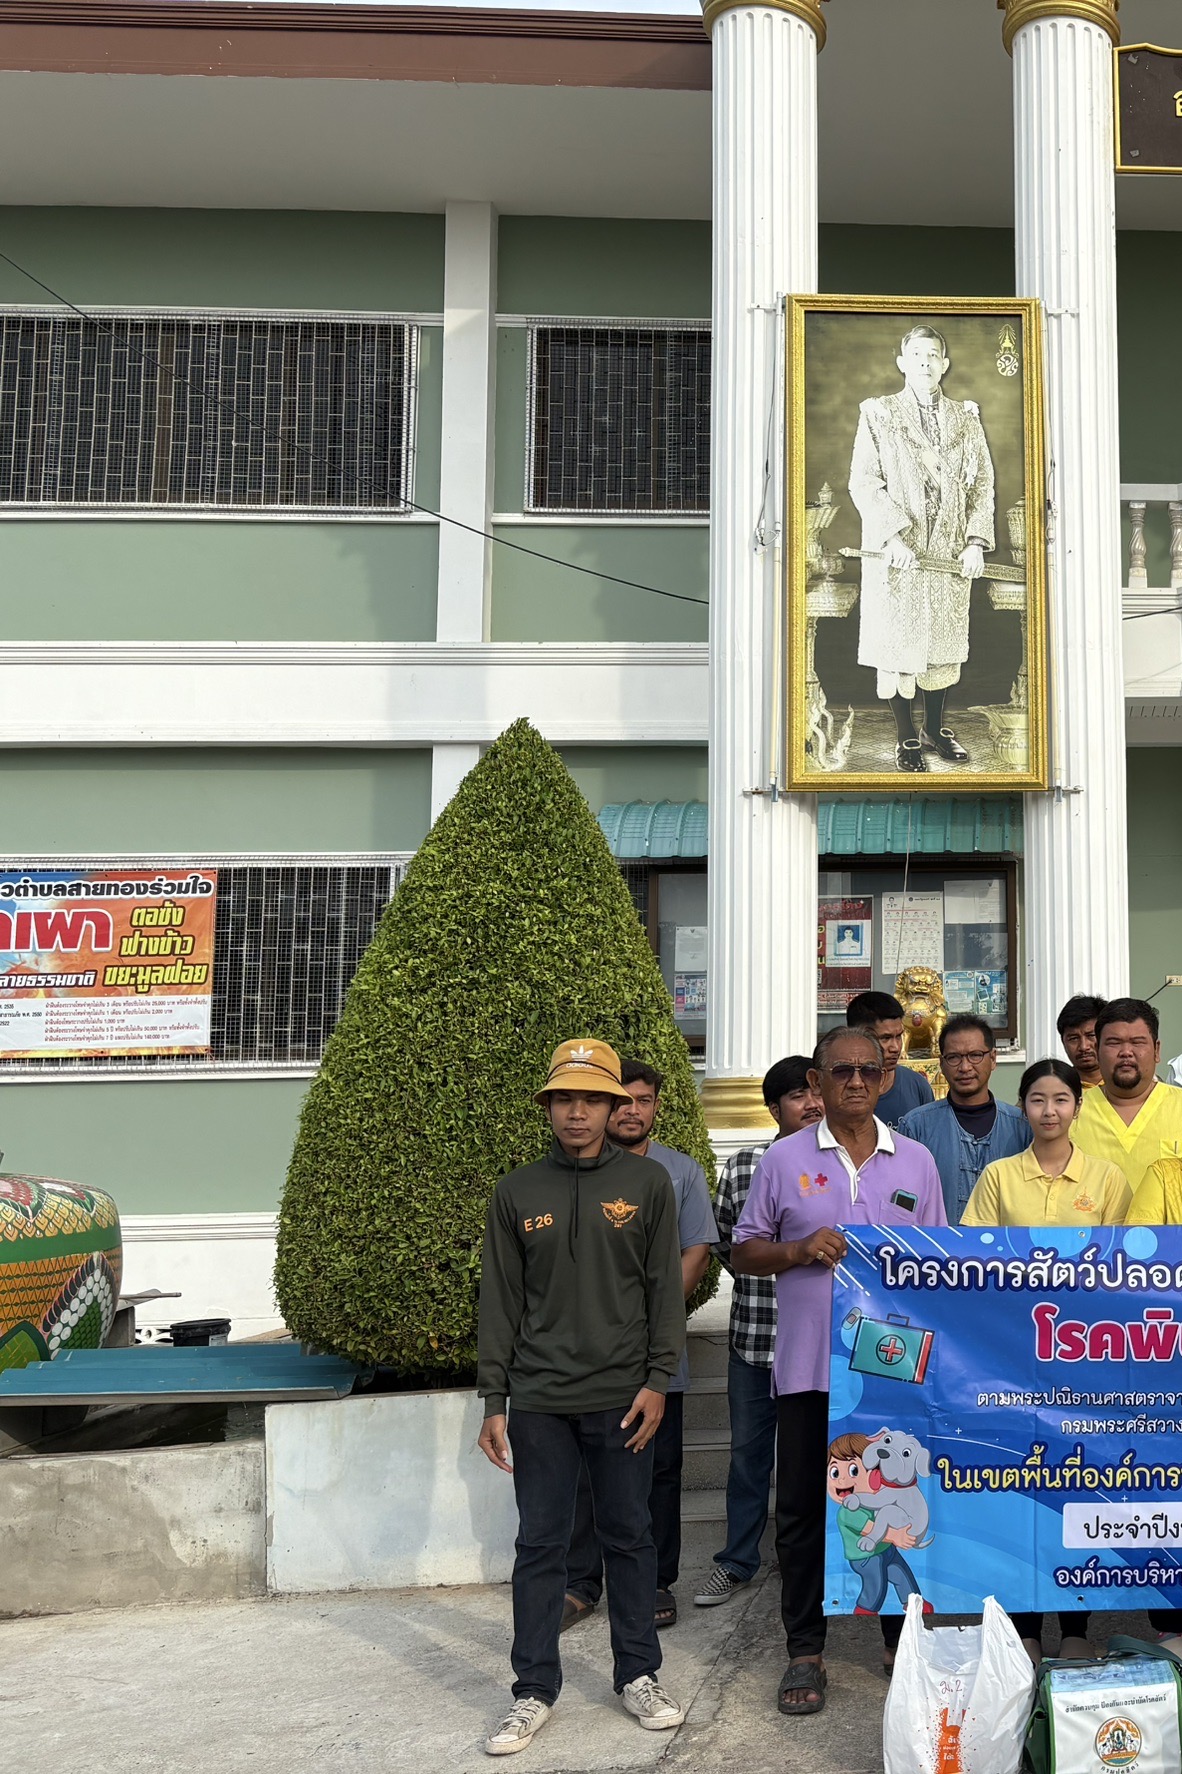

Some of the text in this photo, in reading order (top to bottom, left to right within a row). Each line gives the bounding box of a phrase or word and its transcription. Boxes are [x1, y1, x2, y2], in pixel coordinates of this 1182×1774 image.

[131, 902, 184, 927] ตอซัง
[120, 930, 194, 957] ฟางข้าว
[104, 960, 209, 994] ขยะมูลฝอย
[523, 1213, 554, 1233] E 26
